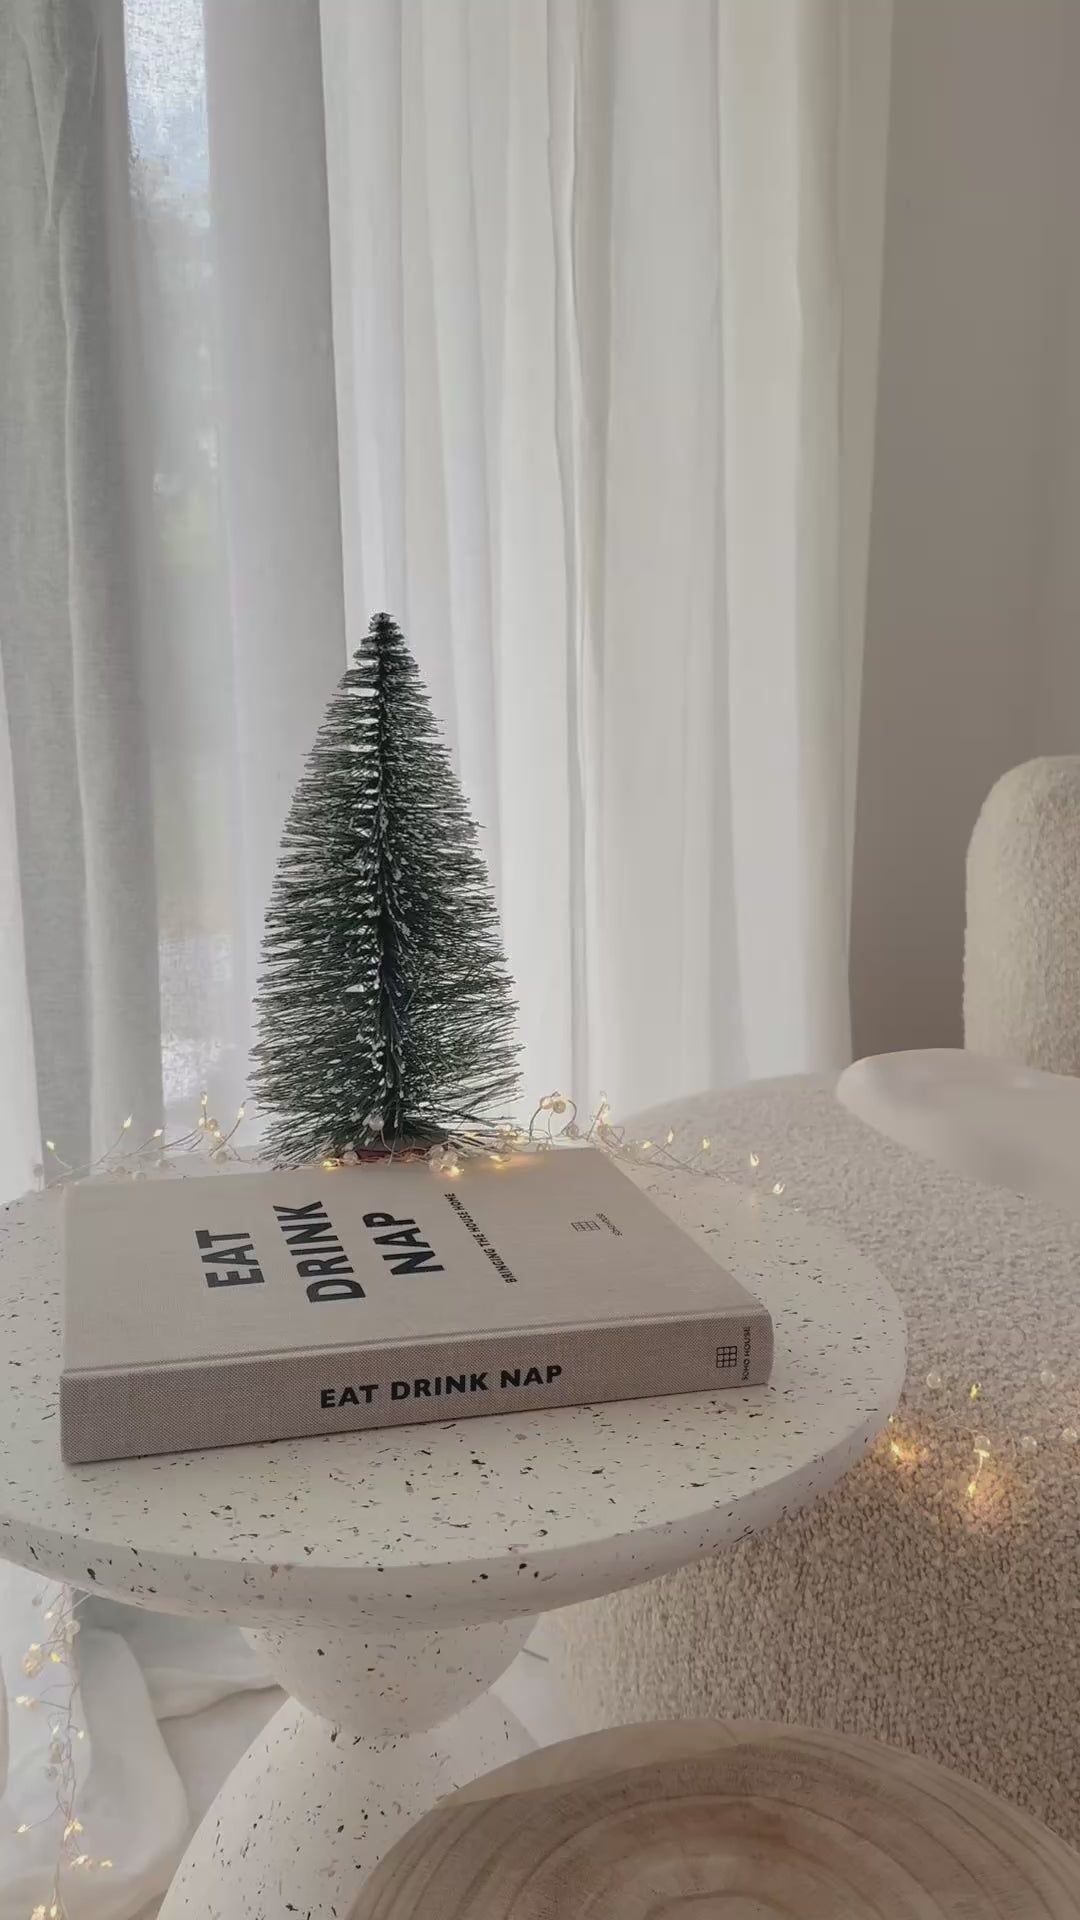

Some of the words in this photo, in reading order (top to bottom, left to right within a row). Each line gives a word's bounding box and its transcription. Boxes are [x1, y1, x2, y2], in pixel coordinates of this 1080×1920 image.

[444, 1192, 465, 1211] HOME
[457, 1210, 481, 1234] HOUSE
[473, 1233, 491, 1248] THE
[195, 1230, 264, 1288] EAT
[272, 1200, 366, 1303] DRINK
[362, 1212, 445, 1275] NAP
[484, 1248, 517, 1284] BRINGING
[320, 1384, 379, 1409] EAT
[391, 1372, 489, 1401] DRINK
[500, 1364, 563, 1389] NAP
